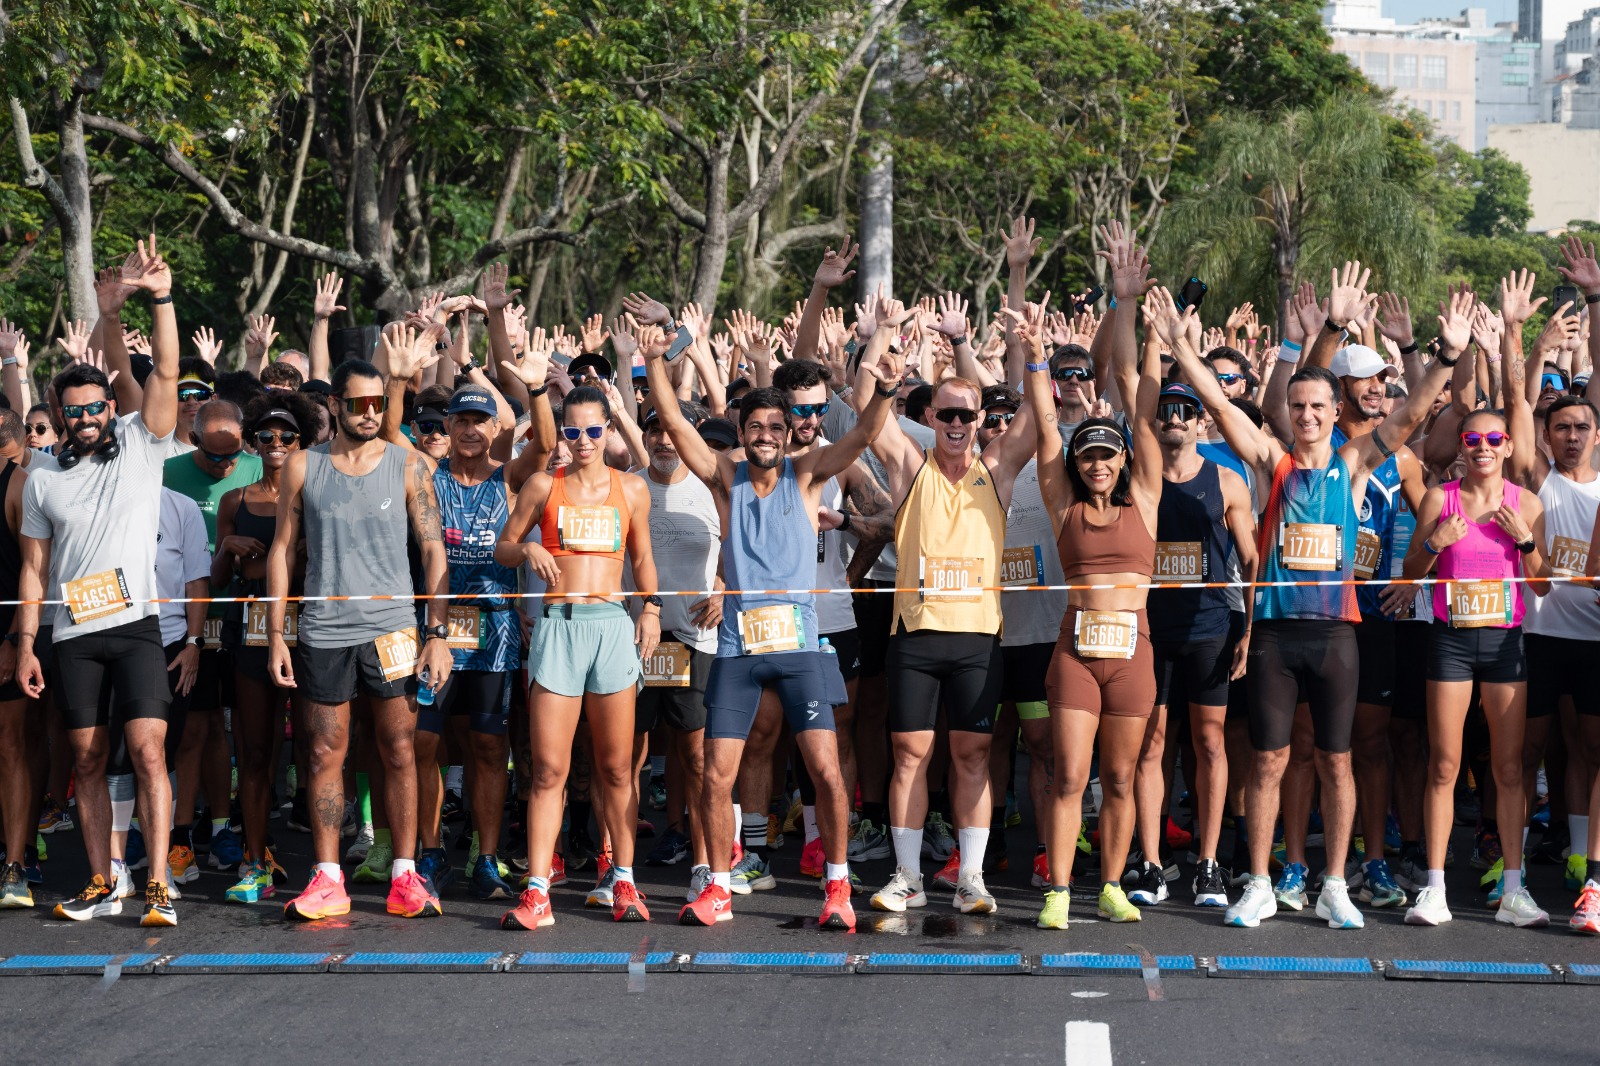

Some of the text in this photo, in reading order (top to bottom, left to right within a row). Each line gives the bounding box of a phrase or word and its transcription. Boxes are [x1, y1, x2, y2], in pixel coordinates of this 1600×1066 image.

[569, 518, 609, 539] 17593
[1290, 536, 1329, 558] 17714
[1335, 536, 1343, 561] QUÊNIA
[1001, 559, 1032, 581] 4890
[1156, 555, 1196, 575] 14889
[1555, 548, 1588, 573] 1429
[119, 575, 128, 598] QUÊNIA
[932, 570, 969, 589] 18010
[73, 584, 117, 612] 14656
[1456, 592, 1499, 615] 16477
[450, 618, 474, 637] 722
[1086, 624, 1124, 646] 15669
[644, 655, 675, 675] 9103
